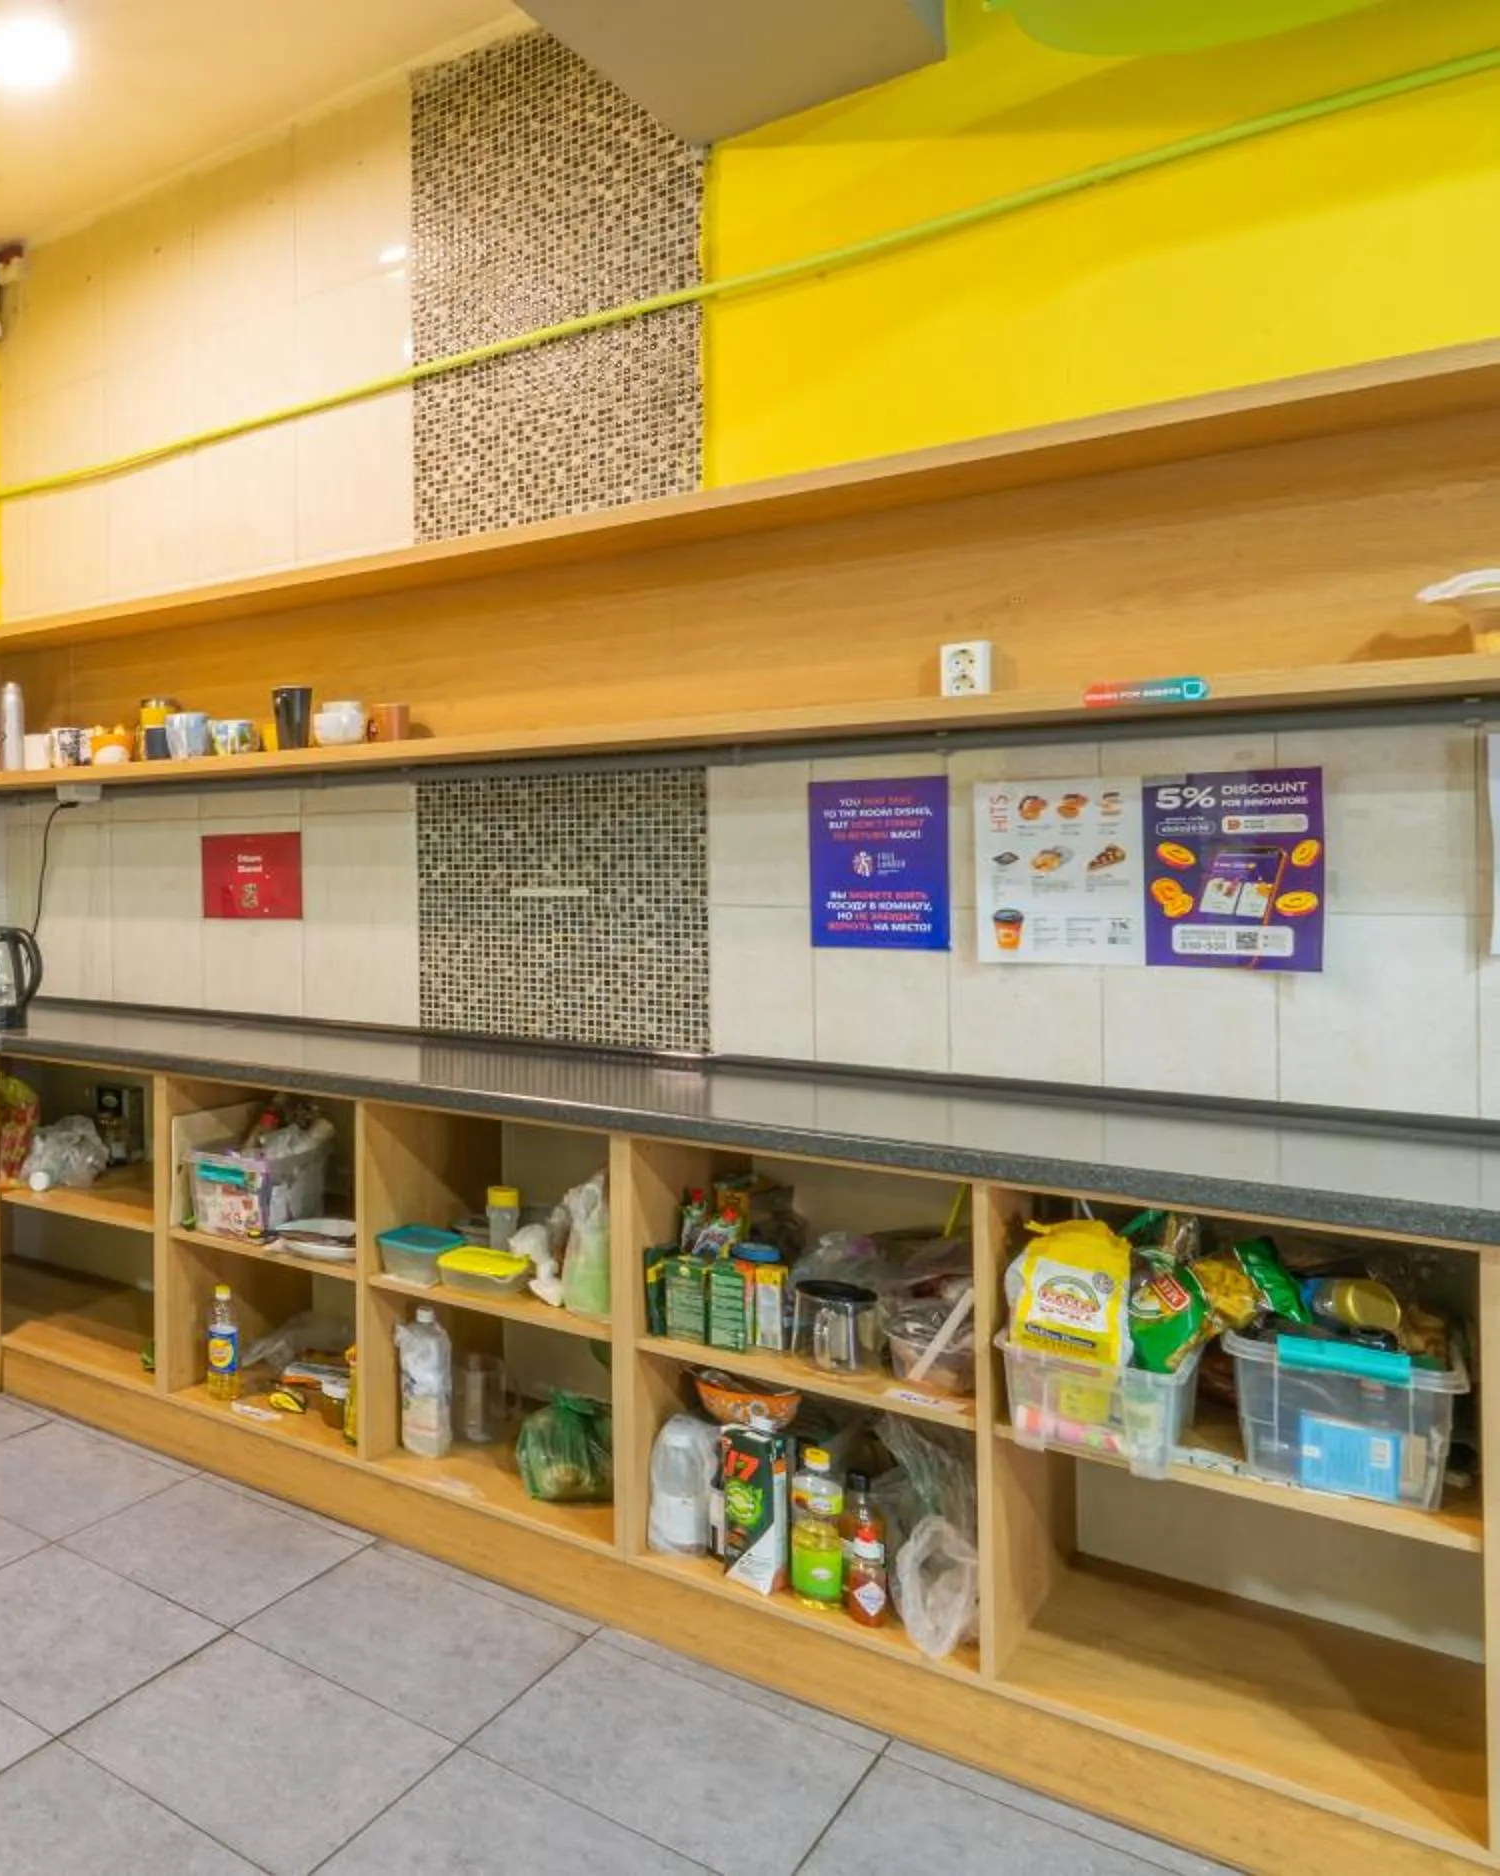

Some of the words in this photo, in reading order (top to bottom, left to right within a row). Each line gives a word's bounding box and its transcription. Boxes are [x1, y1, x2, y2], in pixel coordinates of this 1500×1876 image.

[1156, 786, 1217, 809] 5%
[1221, 781, 1309, 796] DISCOUNT
[840, 798, 860, 807] YOU
[1221, 798, 1242, 808] FOR
[1243, 796, 1309, 807] INNOVATORS
[839, 808, 857, 818] THE
[859, 808, 893, 817] ROOM
[989, 794, 1009, 832] HITS
[828, 820, 848, 829] BUT
[890, 829, 921, 839] BACK!
[837, 911, 853, 921] НО
[873, 922, 889, 932] НА
[891, 922, 933, 932] МЕСТО!
